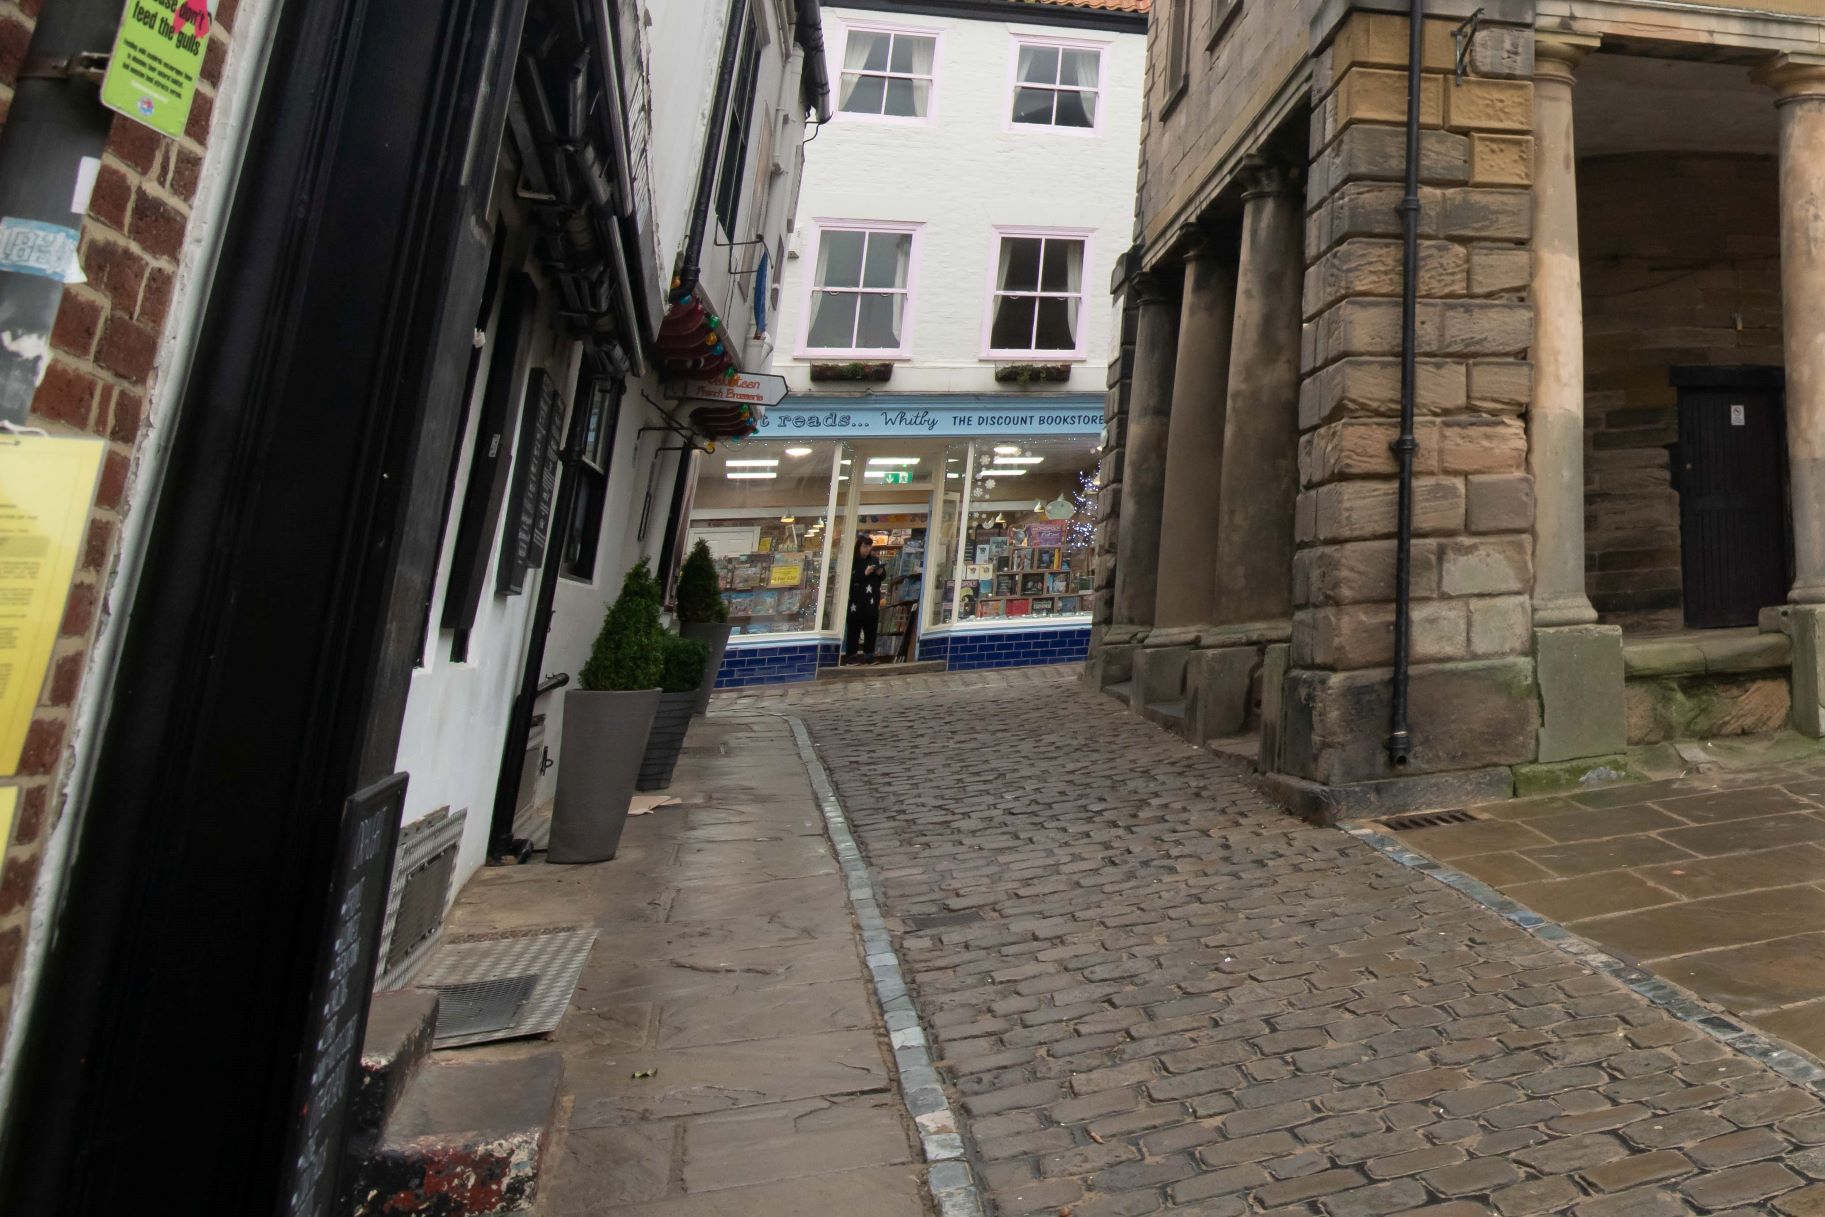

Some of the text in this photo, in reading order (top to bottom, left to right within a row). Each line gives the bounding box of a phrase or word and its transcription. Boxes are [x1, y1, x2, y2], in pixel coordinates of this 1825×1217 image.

[132, 0, 201, 57] feed the gulls
[178, 1, 205, 31] don't
[880, 411, 939, 431] Whitby
[952, 414, 1104, 426] THE DISCOUNT BOOKSTORE
